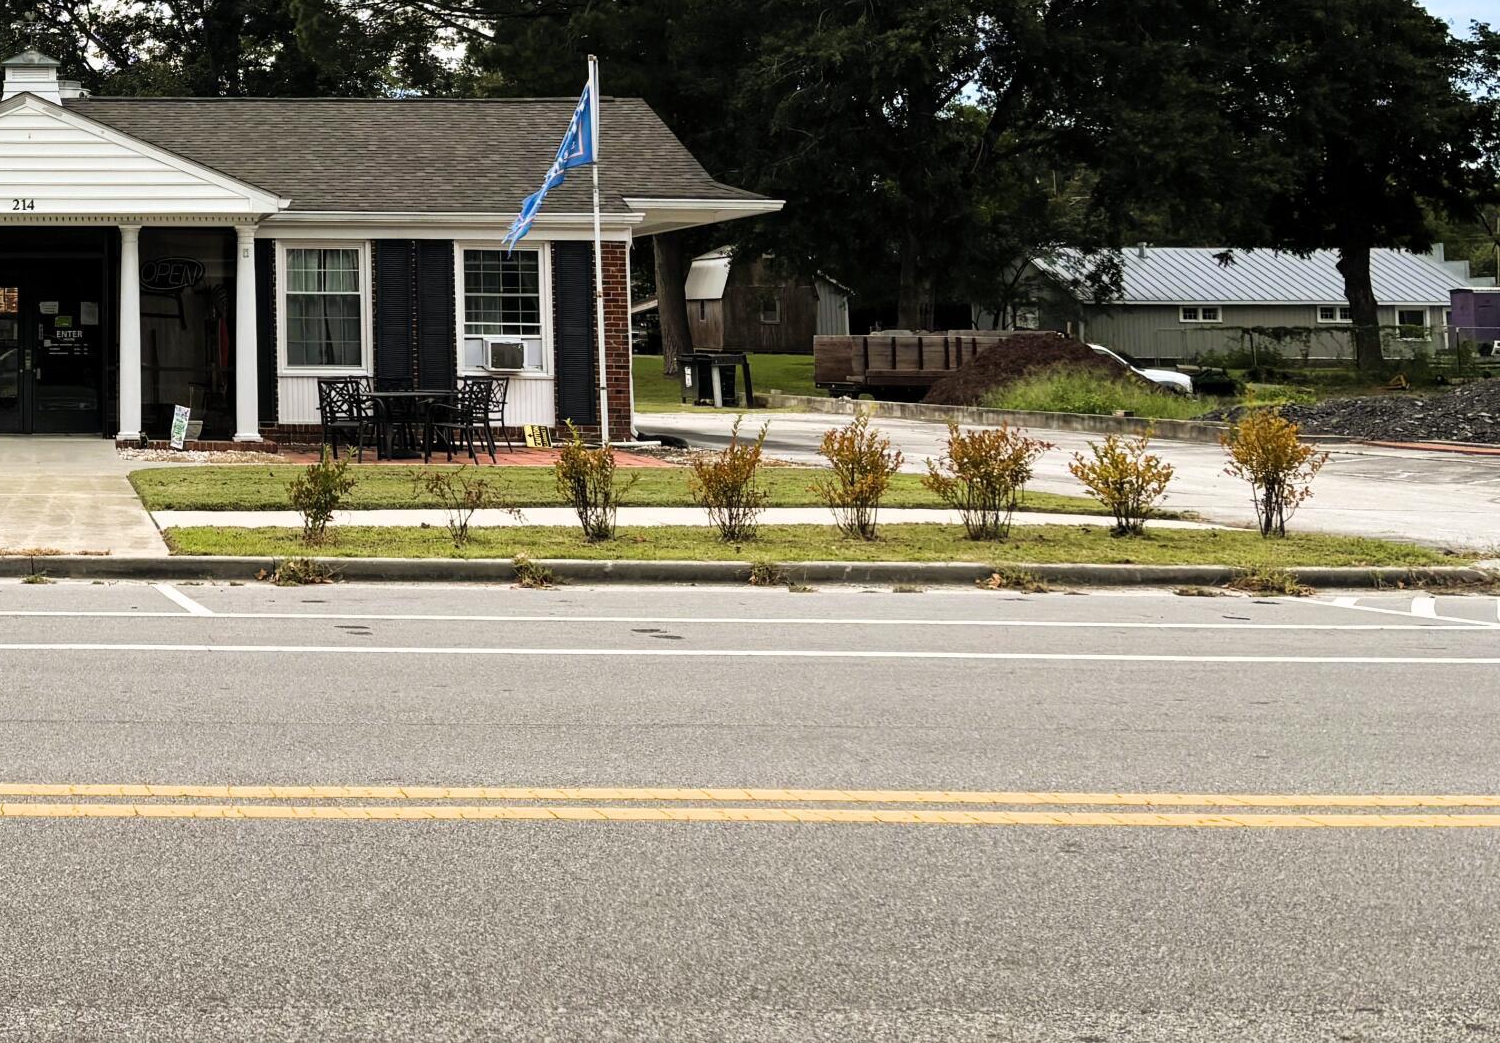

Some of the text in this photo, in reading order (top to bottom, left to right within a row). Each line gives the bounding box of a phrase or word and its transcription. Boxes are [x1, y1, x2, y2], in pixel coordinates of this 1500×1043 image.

[12, 198, 35, 211] 214
[141, 261, 197, 286] OPEN
[56, 330, 83, 338] ENTER
